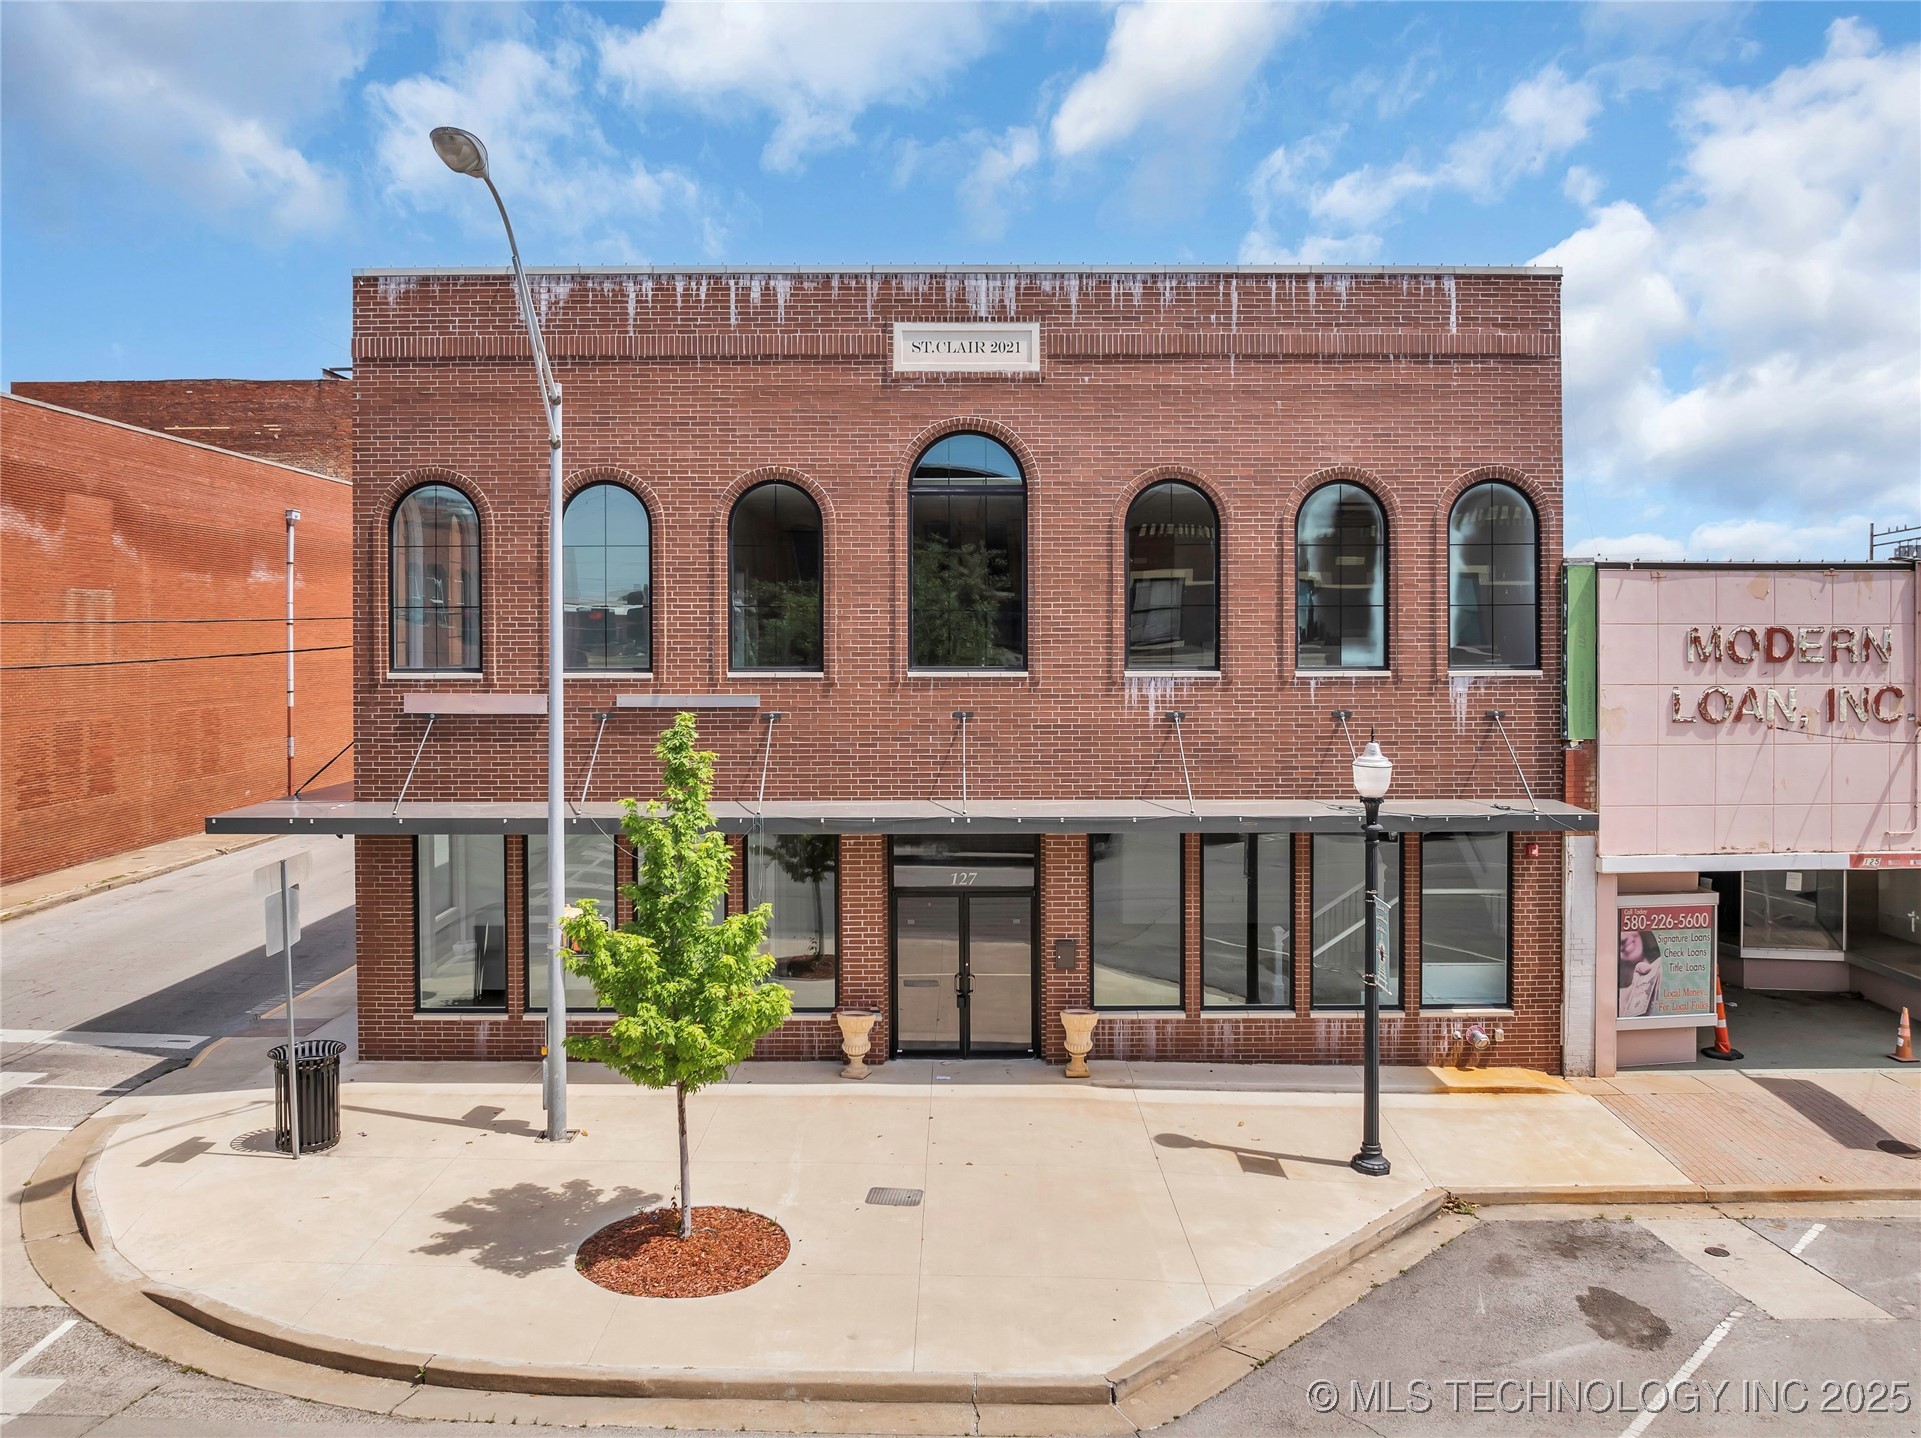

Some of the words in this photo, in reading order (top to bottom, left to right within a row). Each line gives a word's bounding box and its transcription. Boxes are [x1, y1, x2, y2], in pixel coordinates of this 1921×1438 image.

[990, 341, 1021, 354] 2021
[1686, 625, 1892, 664] MODERN
[1672, 685, 1809, 729] LOAN,
[950, 872, 978, 886] 127
[1623, 912, 1709, 930] 580-226-5600
[1657, 934, 1689, 945] Signature
[1691, 933, 1710, 942] Loans
[1664, 948, 1684, 958] Check
[1687, 948, 1707, 957] Loans
[1669, 962, 1683, 972] Title
[1685, 962, 1706, 971] Loans
[1663, 989, 1680, 998] Local
[1672, 1002, 1689, 1011] Local
[1691, 1001, 1709, 1010] Folks
